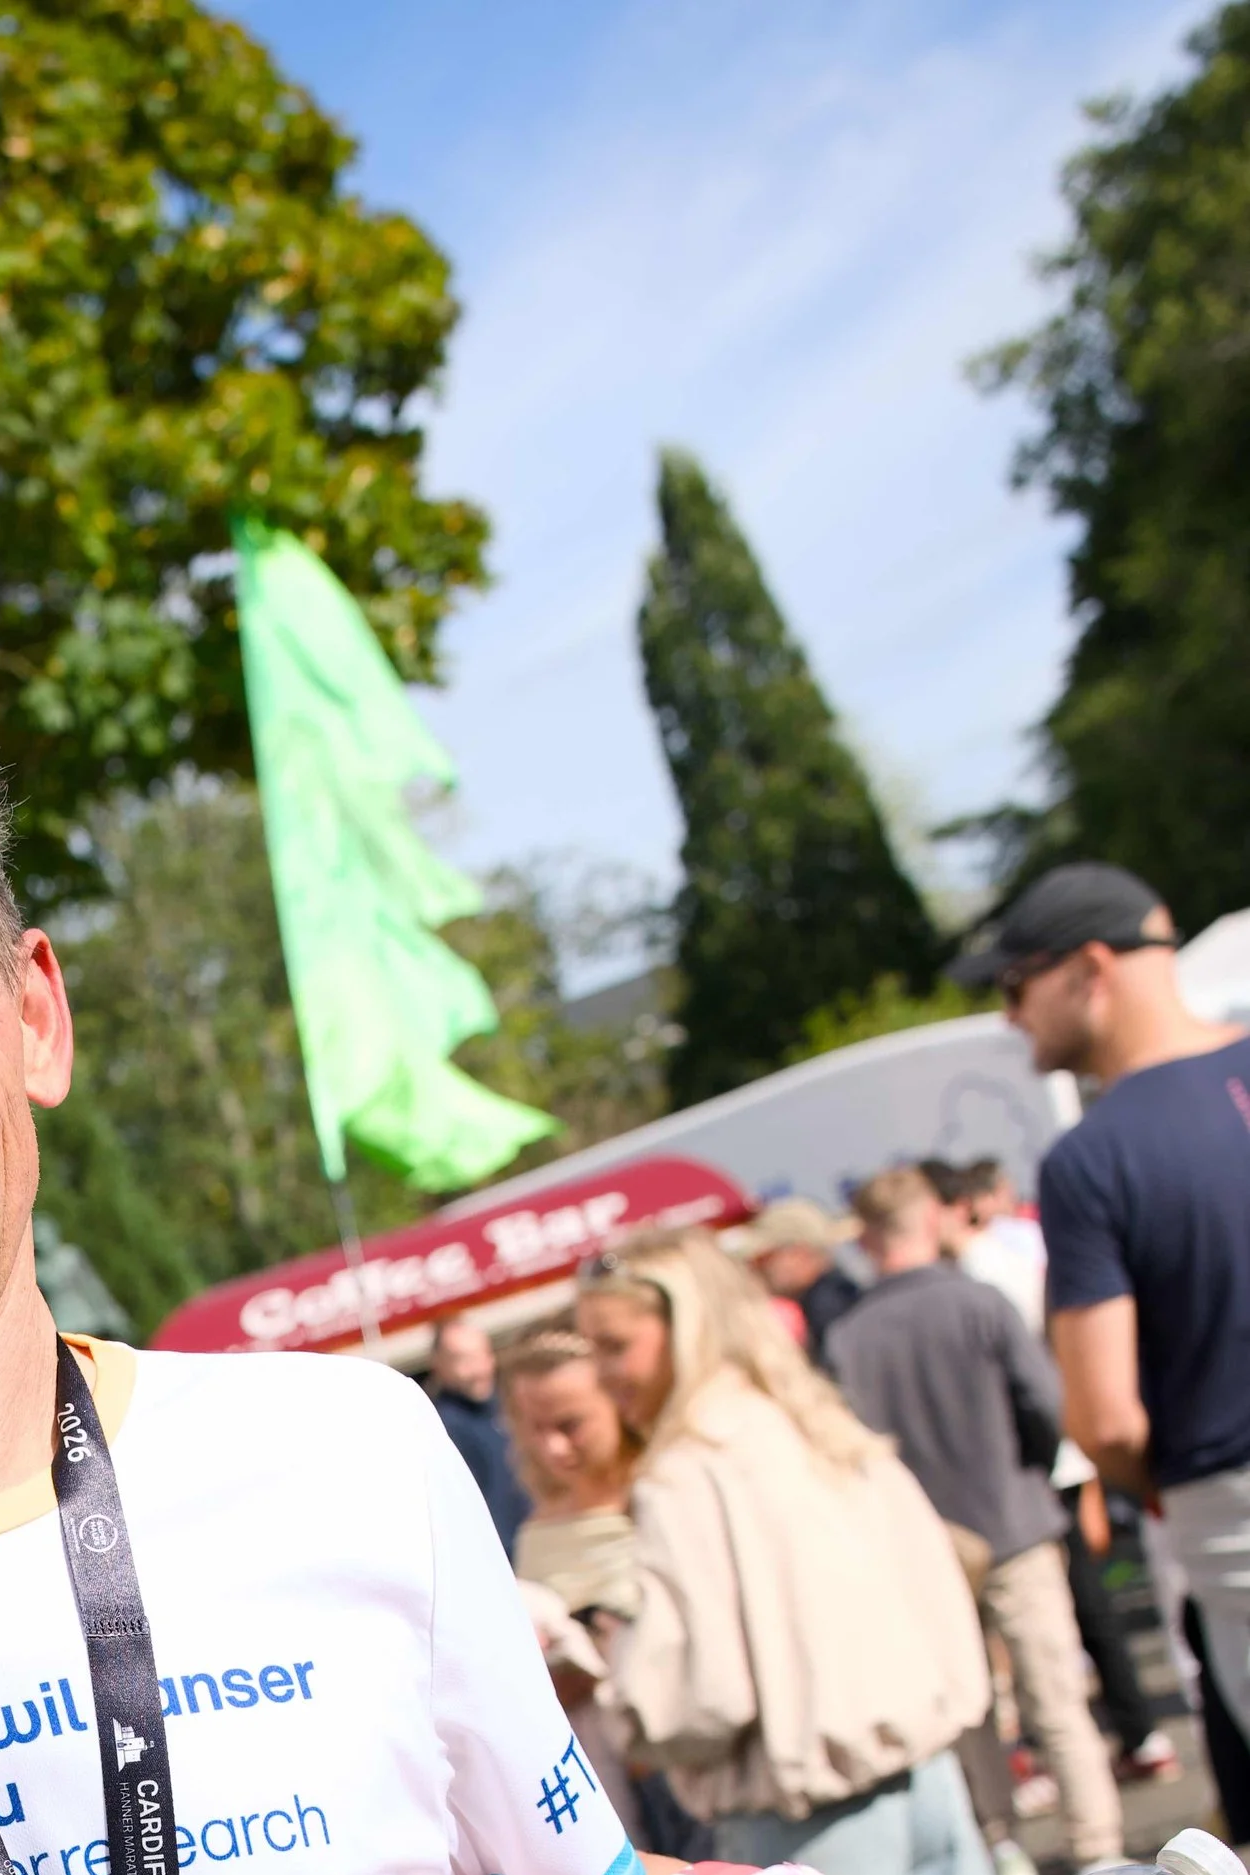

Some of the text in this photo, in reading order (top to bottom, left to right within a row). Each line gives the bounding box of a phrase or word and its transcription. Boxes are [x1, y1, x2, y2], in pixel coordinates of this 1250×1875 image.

[239, 1241, 477, 1340] Coffee
[483, 1191, 630, 1263] Bar
[157, 1660, 315, 1718] anser
[118, 1781, 133, 1832] HANNER
